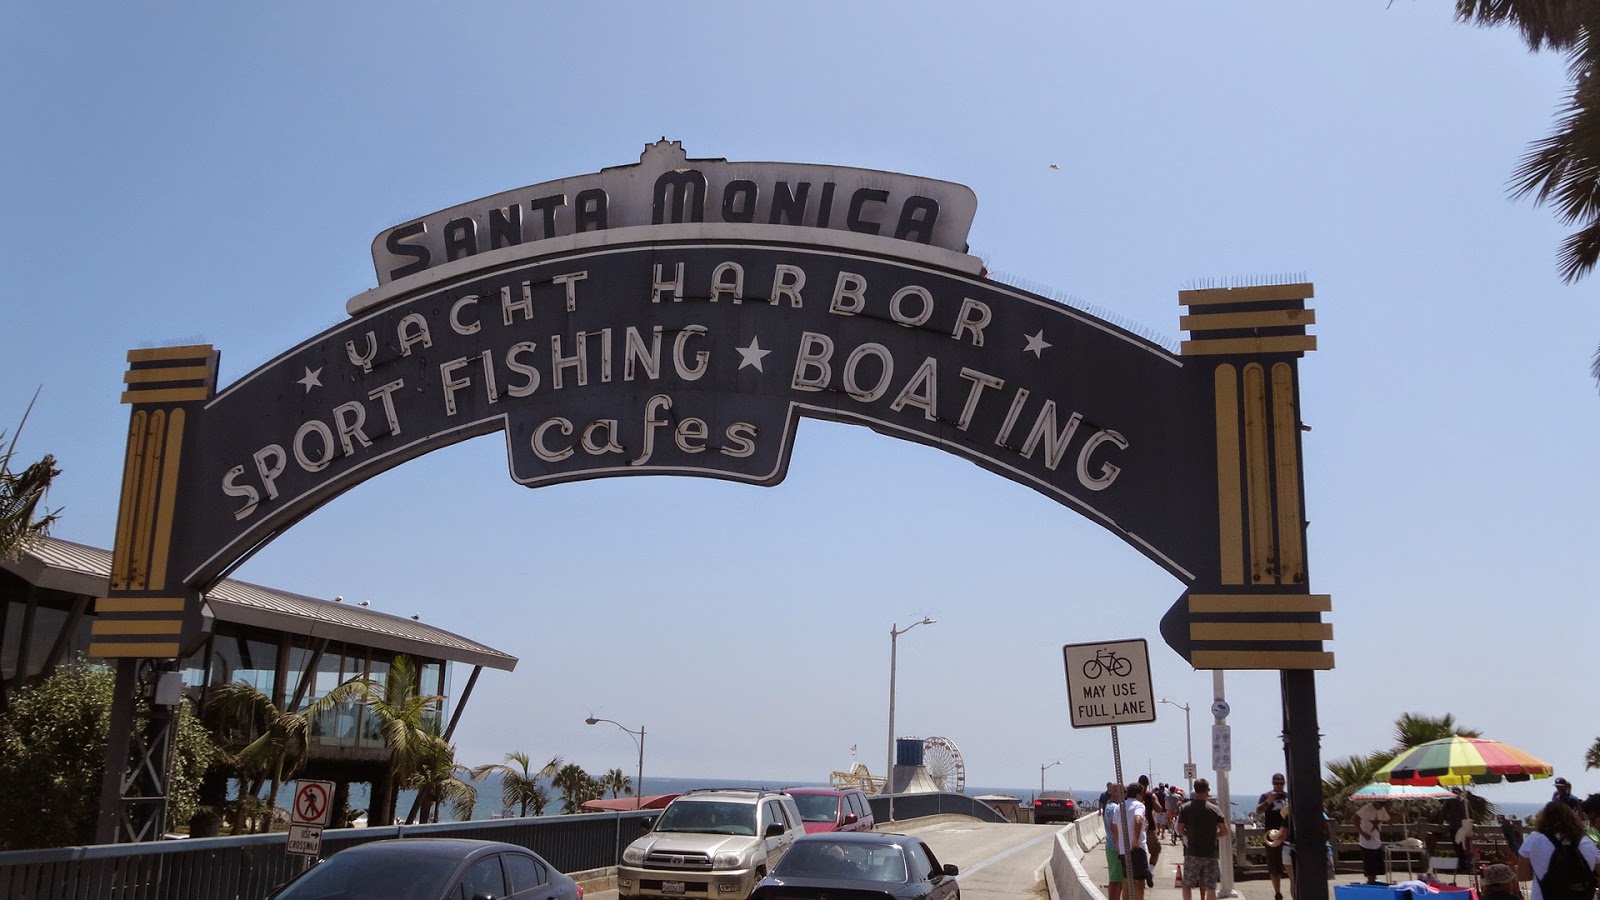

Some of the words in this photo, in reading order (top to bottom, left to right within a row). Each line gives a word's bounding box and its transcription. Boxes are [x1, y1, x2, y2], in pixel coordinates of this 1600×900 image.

[385, 188, 609, 277] SANTA
[652, 169, 941, 245] MONICA
[346, 270, 588, 374] YACHT
[651, 261, 993, 347] HARBOR
[221, 378, 405, 521] SPORT
[439, 324, 711, 417] FISHING
[790, 331, 1130, 492] BOATING
[530, 393, 760, 467] cafes
[1078, 705, 1109, 718] FULL
[1114, 700, 1147, 716] LANE
[1083, 685, 1106, 699] MAY
[1112, 682, 1137, 697] USE
[289, 840, 318, 851] CROSSWALK
[300, 829, 311, 839] USE
